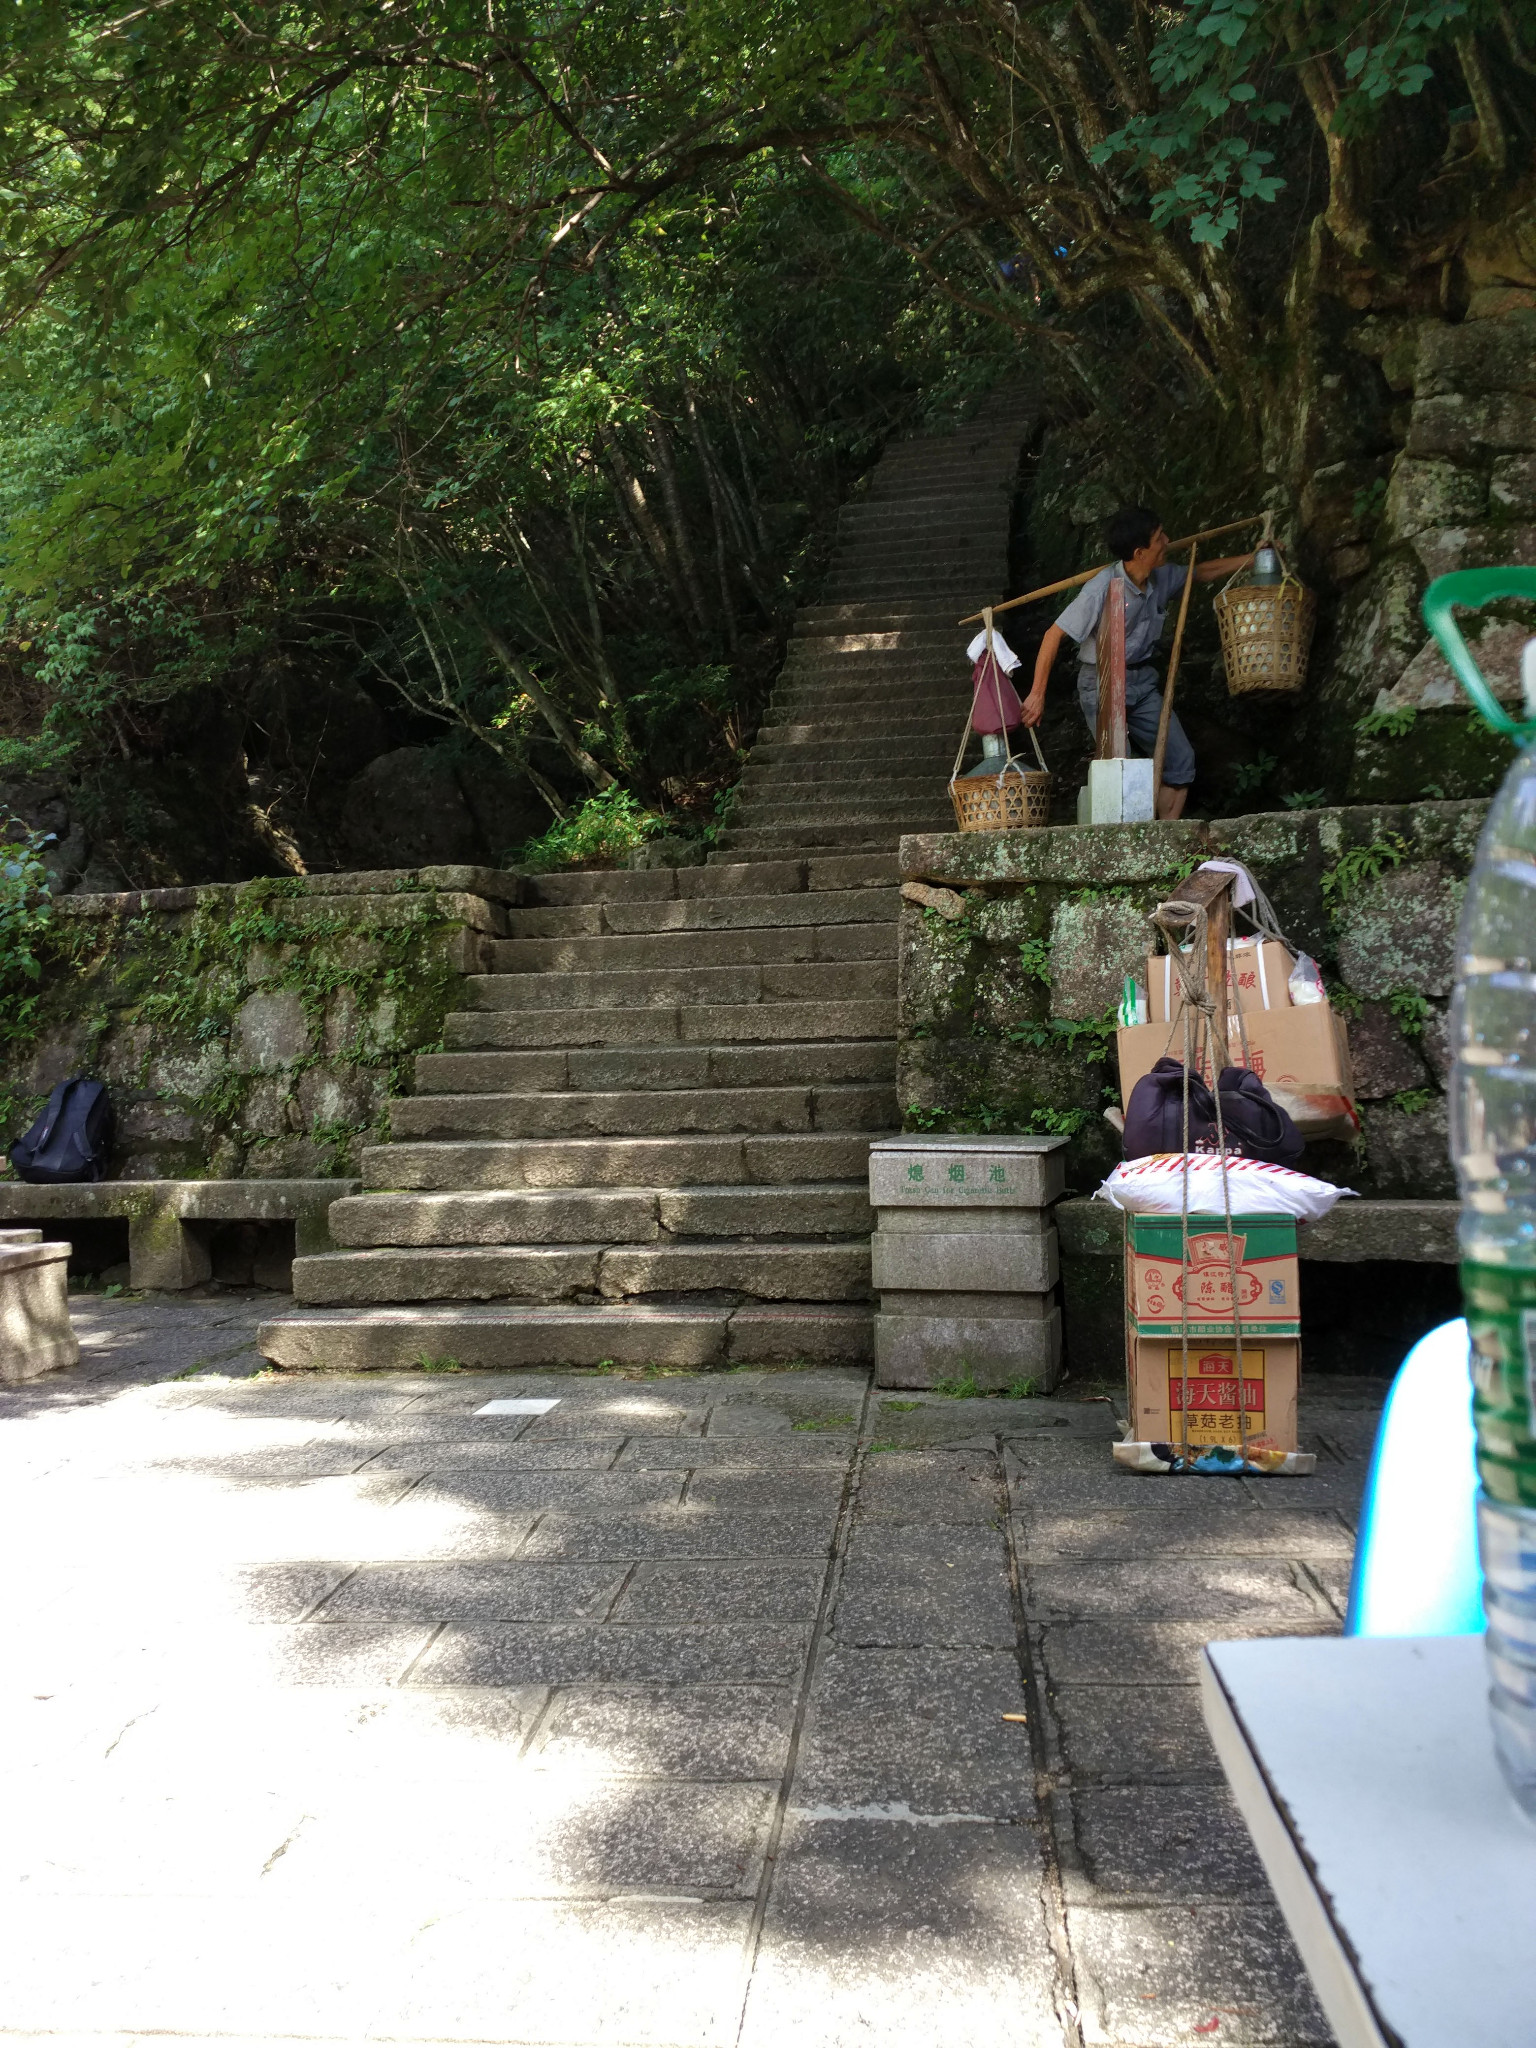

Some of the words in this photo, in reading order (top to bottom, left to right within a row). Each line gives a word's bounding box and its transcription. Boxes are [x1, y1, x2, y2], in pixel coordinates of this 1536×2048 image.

[1195, 1146, 1242, 1155] Kappa
[908, 1164, 1006, 1183] 熄烟池
[943, 1186, 954, 1194] for
[1202, 1360, 1230, 1373] 海天
[1175, 1382, 1257, 1406] 海天酱油
